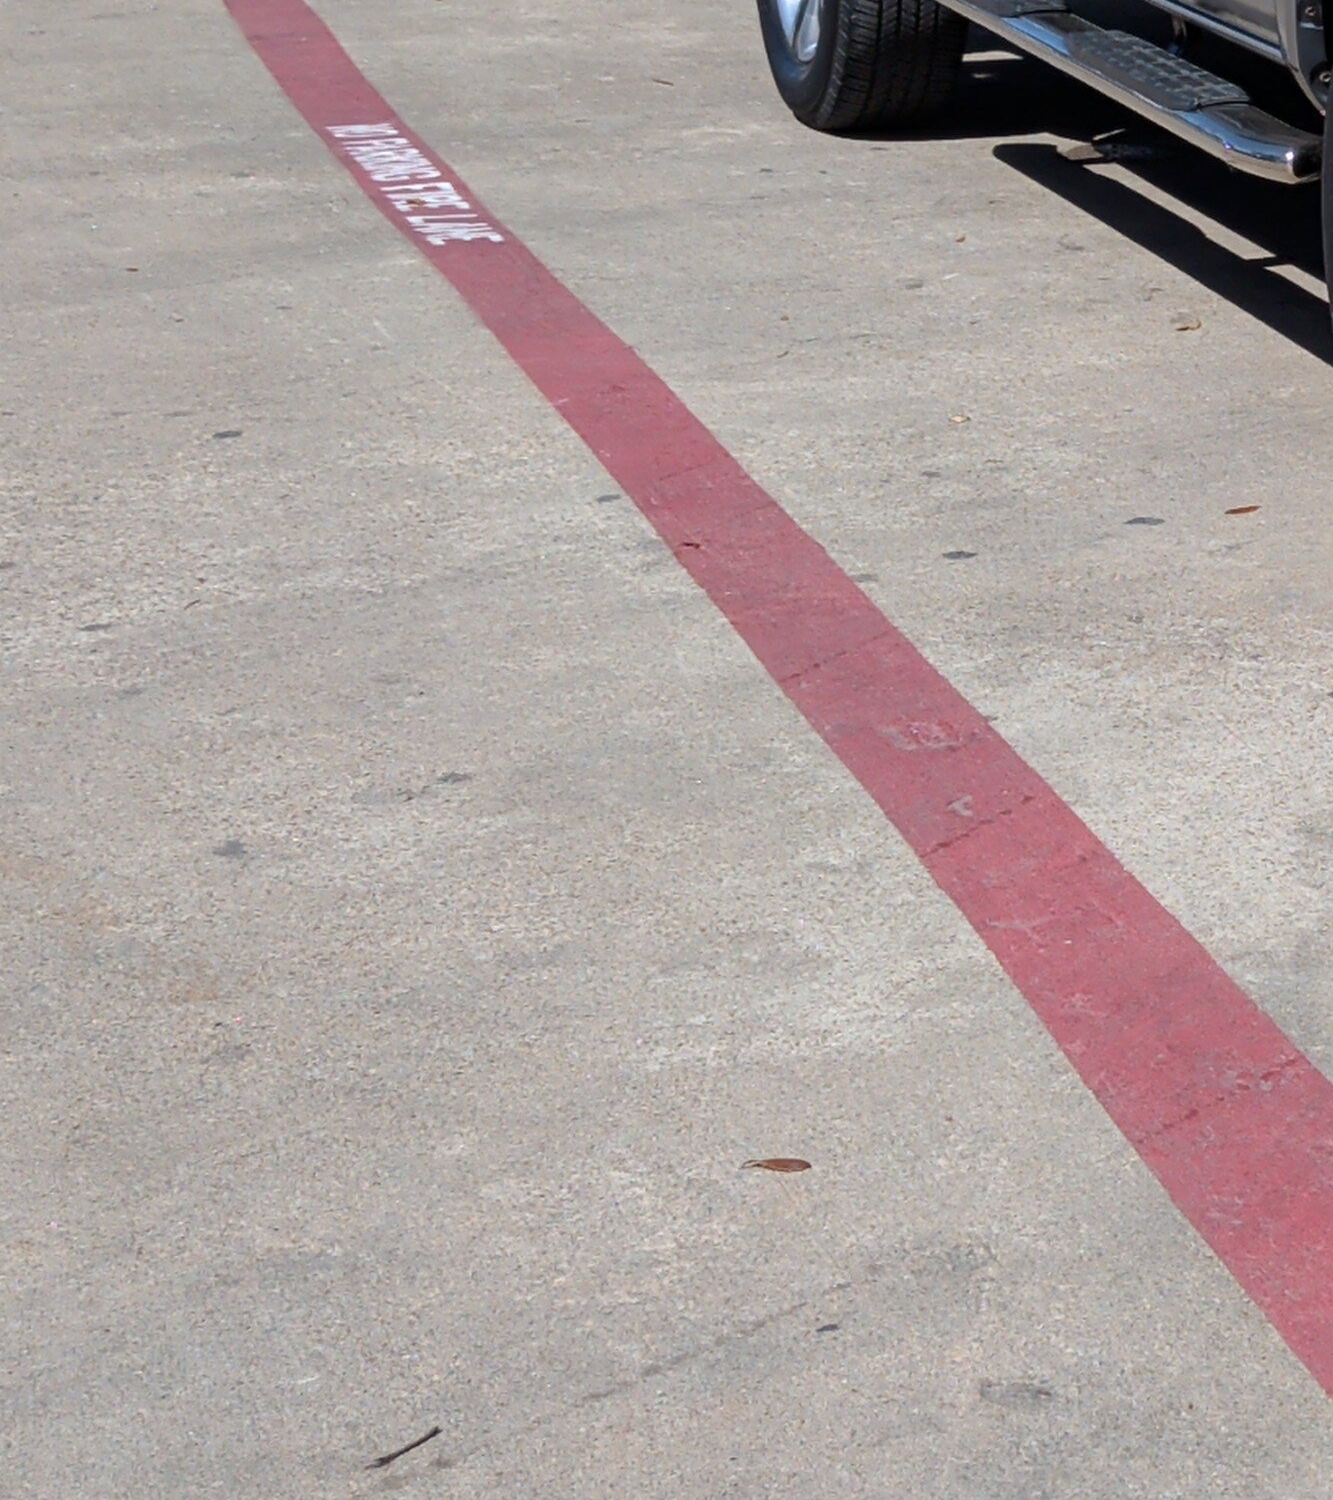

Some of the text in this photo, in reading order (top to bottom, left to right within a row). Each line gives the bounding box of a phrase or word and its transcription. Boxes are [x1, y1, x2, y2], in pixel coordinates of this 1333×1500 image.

[325, 123, 504, 246] NO PARKING FIRE LANE
